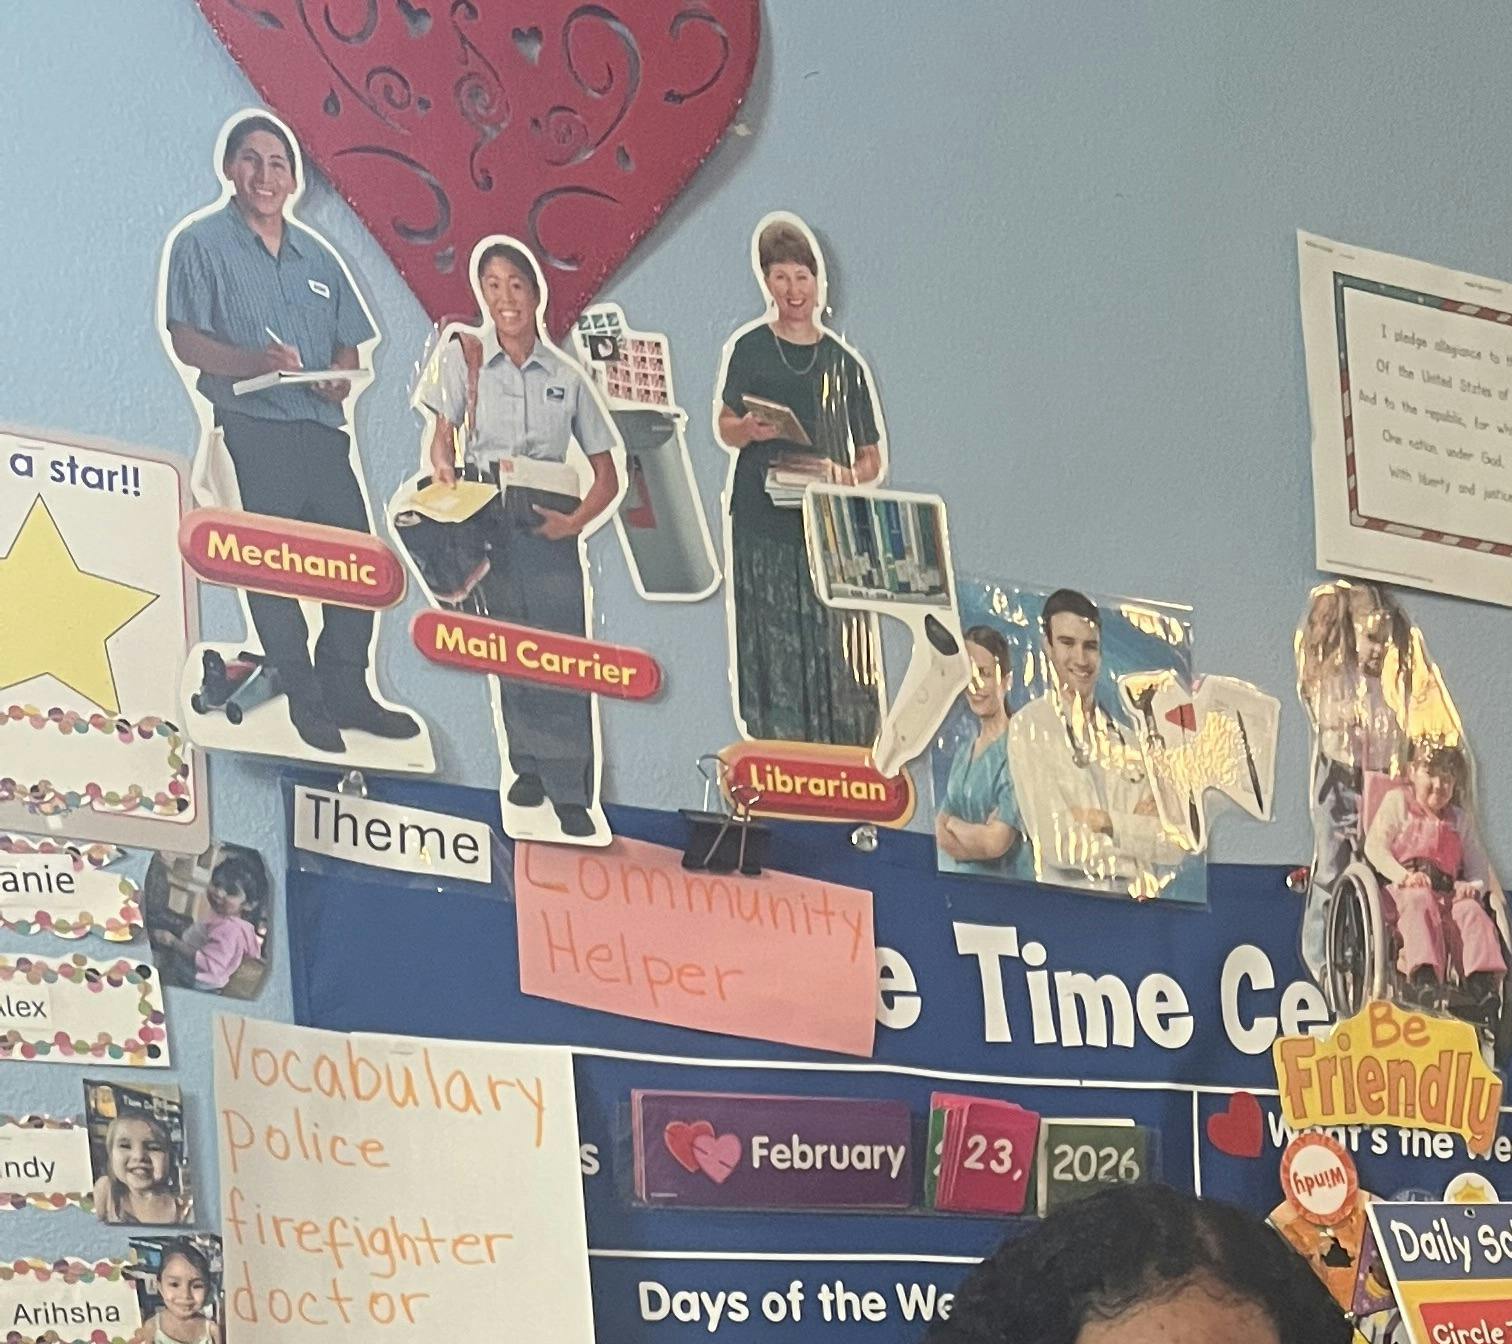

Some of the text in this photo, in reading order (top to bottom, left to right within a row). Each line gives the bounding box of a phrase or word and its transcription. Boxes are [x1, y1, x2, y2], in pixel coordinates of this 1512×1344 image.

[1399, 364, 1415, 380] the
[1459, 379, 1492, 398] States
[10, 453, 141, 497] a star!!
[207, 530, 377, 586] Mechanic
[435, 623, 637, 686] Mail Carrier
[750, 764, 887, 801] Librarian
[305, 793, 480, 864] Theme
[525, 846, 864, 963] Community
[541, 910, 744, 1008] Helper
[952, 921, 1194, 1050] Time
[1367, 1001, 1431, 1049] Be
[220, 1017, 546, 1149] Vocabulary
[1281, 1033, 1502, 1155] Friendly
[751, 1134, 1141, 1184] February 23, 2026
[1399, 1128, 1455, 1160] the
[228, 1186, 514, 1278] firefighter
[1390, 1218, 1470, 1273] Daily
[13, 1300, 121, 1326] Arihsha
[233, 1260, 430, 1326] doctor
[638, 1280, 749, 1333] Days
[761, 1280, 806, 1322] of
[818, 1280, 887, 1322] the
